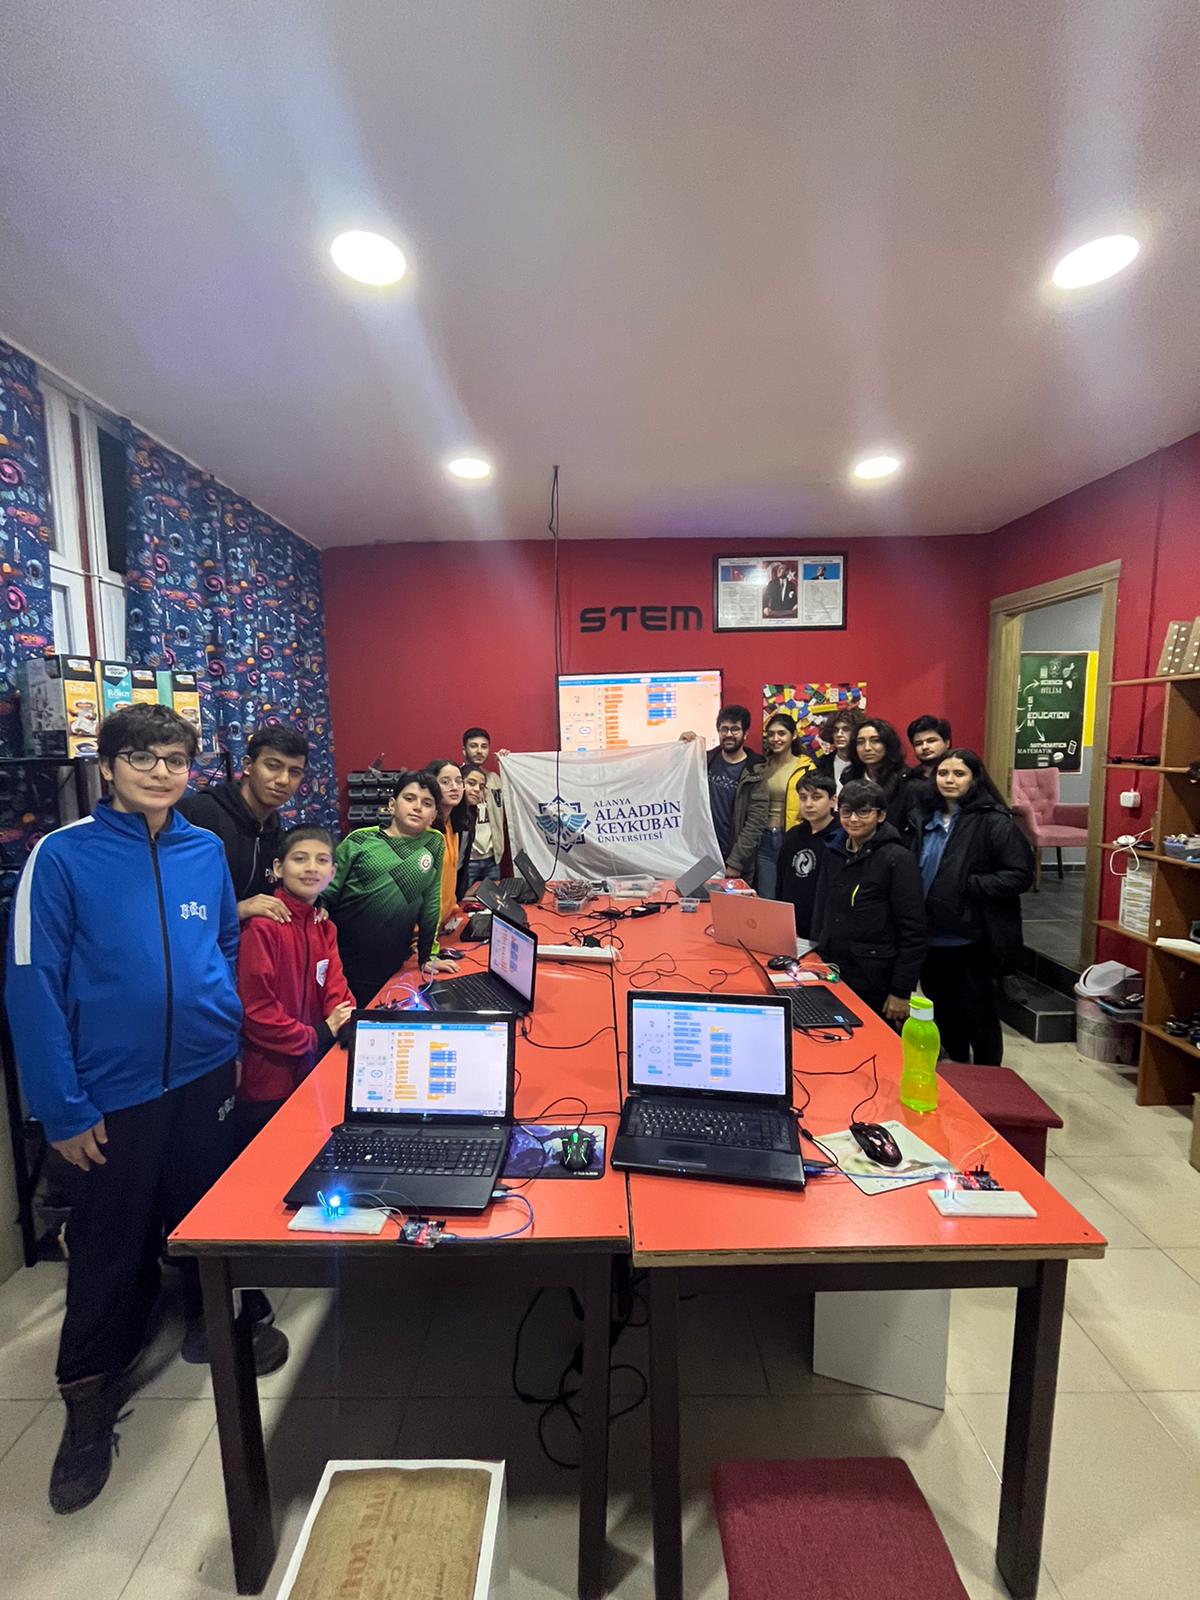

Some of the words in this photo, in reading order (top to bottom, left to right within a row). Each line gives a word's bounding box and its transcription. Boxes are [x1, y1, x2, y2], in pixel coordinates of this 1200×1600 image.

[580, 606, 703, 633] STEM
[1027, 711, 1070, 719] EDUCATION
[593, 798, 631, 808] ALANYA
[595, 799, 681, 822] ALAADDİN
[596, 815, 681, 834] KEYKUBAT
[597, 831, 663, 843] ÜNİVERSİTESİ
